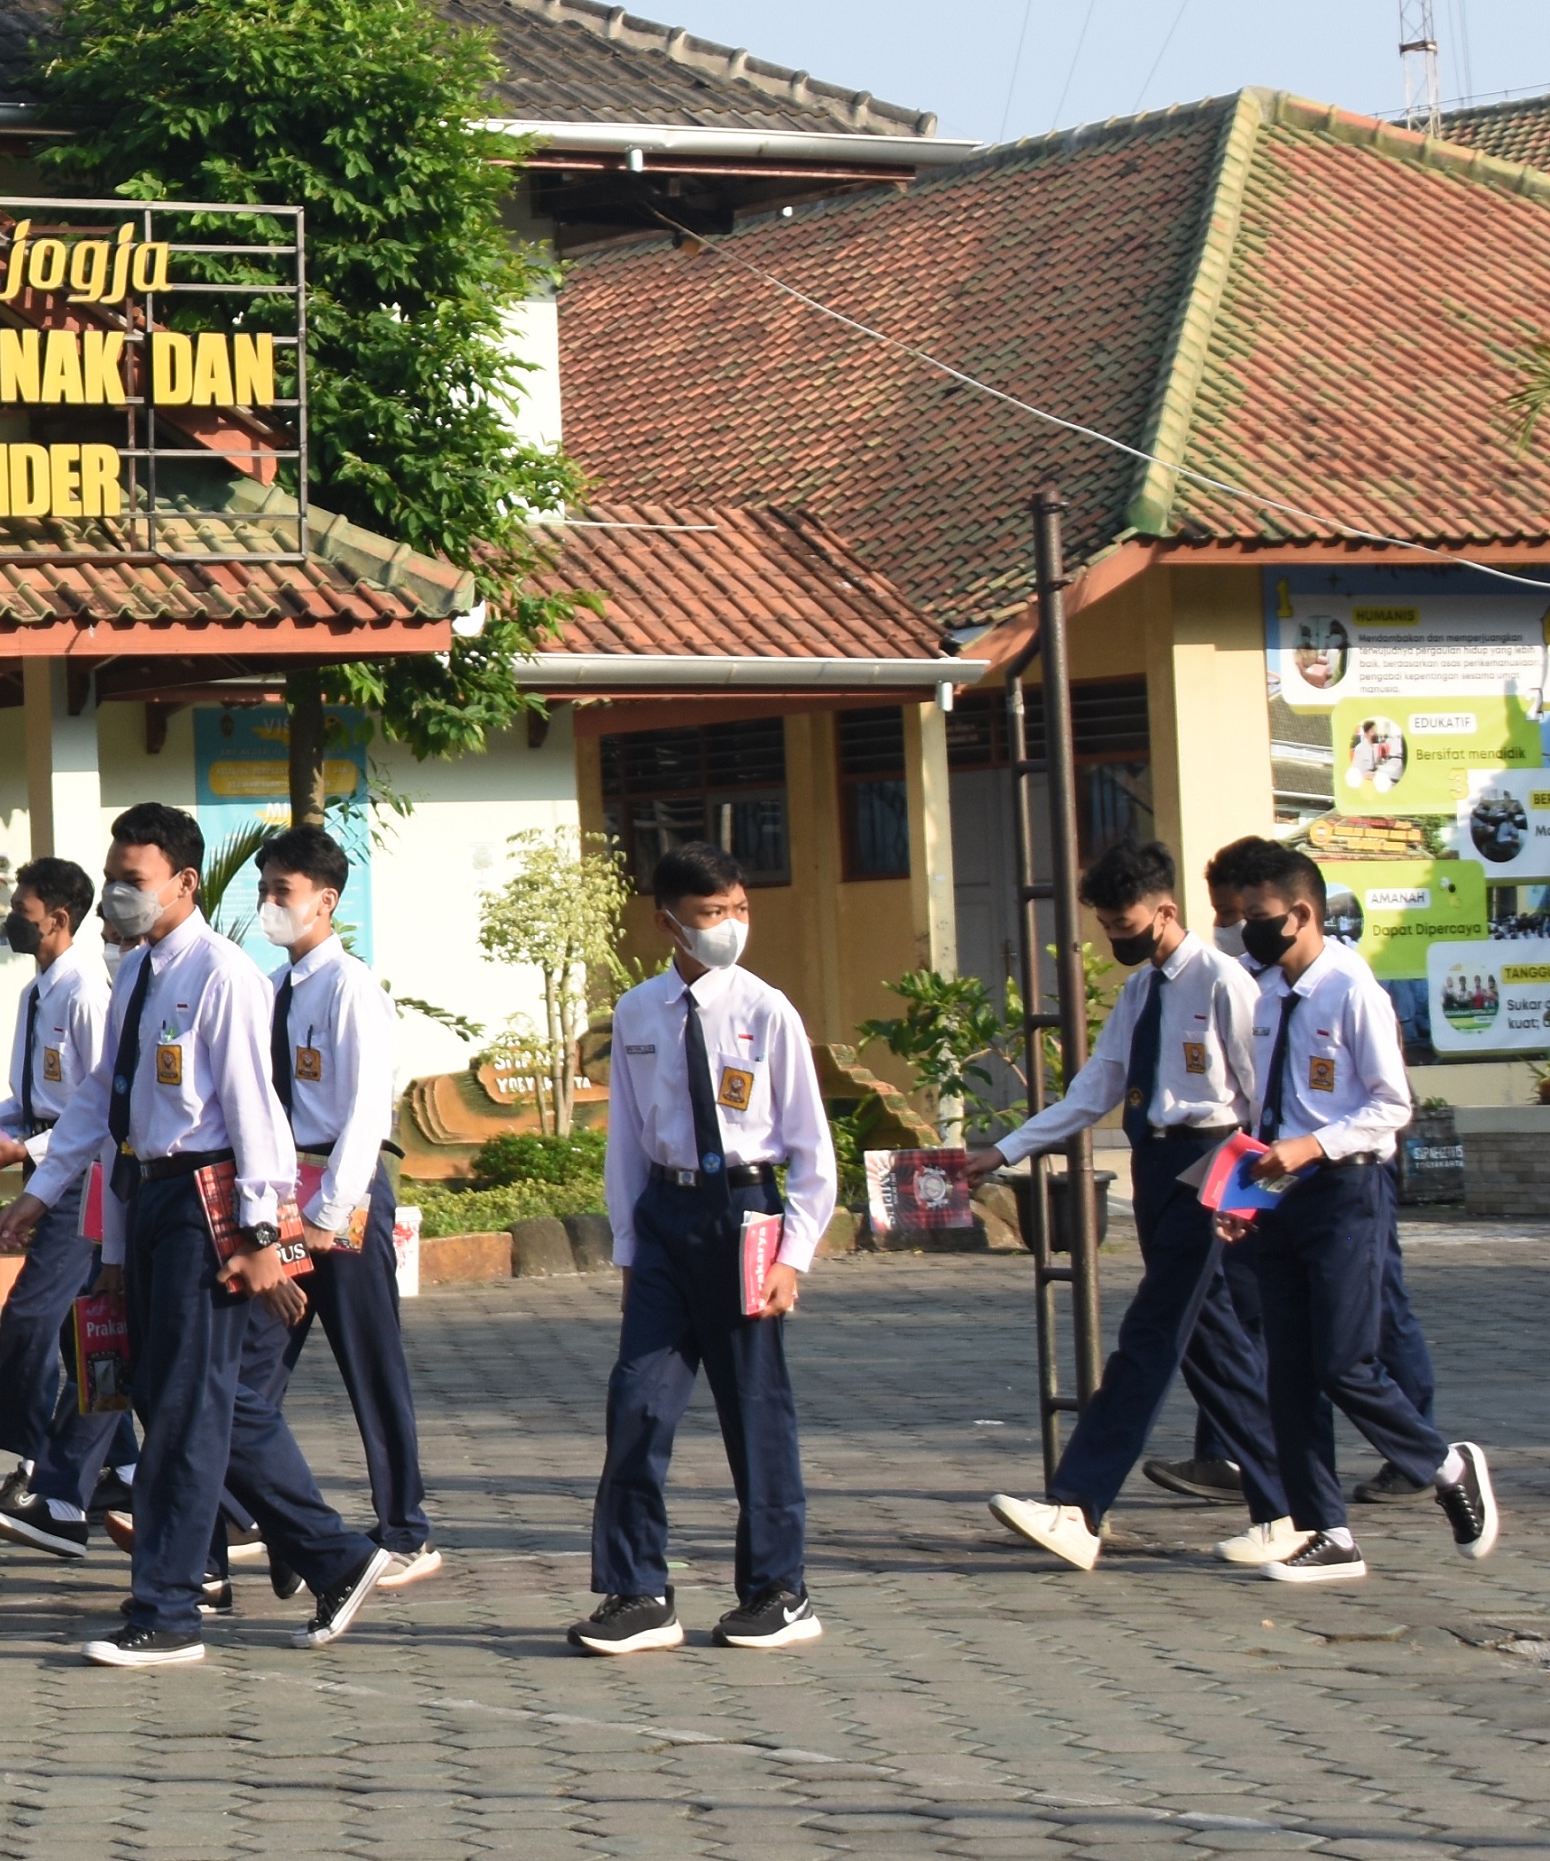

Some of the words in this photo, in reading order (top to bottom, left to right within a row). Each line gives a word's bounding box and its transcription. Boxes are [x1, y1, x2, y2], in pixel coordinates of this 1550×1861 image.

[151, 331, 276, 406] DAN
[1356, 610, 1416, 622] HUMANIS
[1358, 633, 1425, 643] Mendambakan
[1427, 633, 1444, 643] dan
[1446, 633, 1523, 645] memperjuangkan
[1490, 646, 1512, 656] yang
[1414, 717, 1471, 728] EDUKATIF
[1416, 748, 1466, 761] Bersifat
[1468, 748, 1526, 760] mendidik
[1370, 892, 1426, 904] AMANAH
[1373, 925, 1412, 939] Dapat
[1416, 923, 1482, 938] Dipercaya
[1507, 998, 1542, 1011] Sukar
